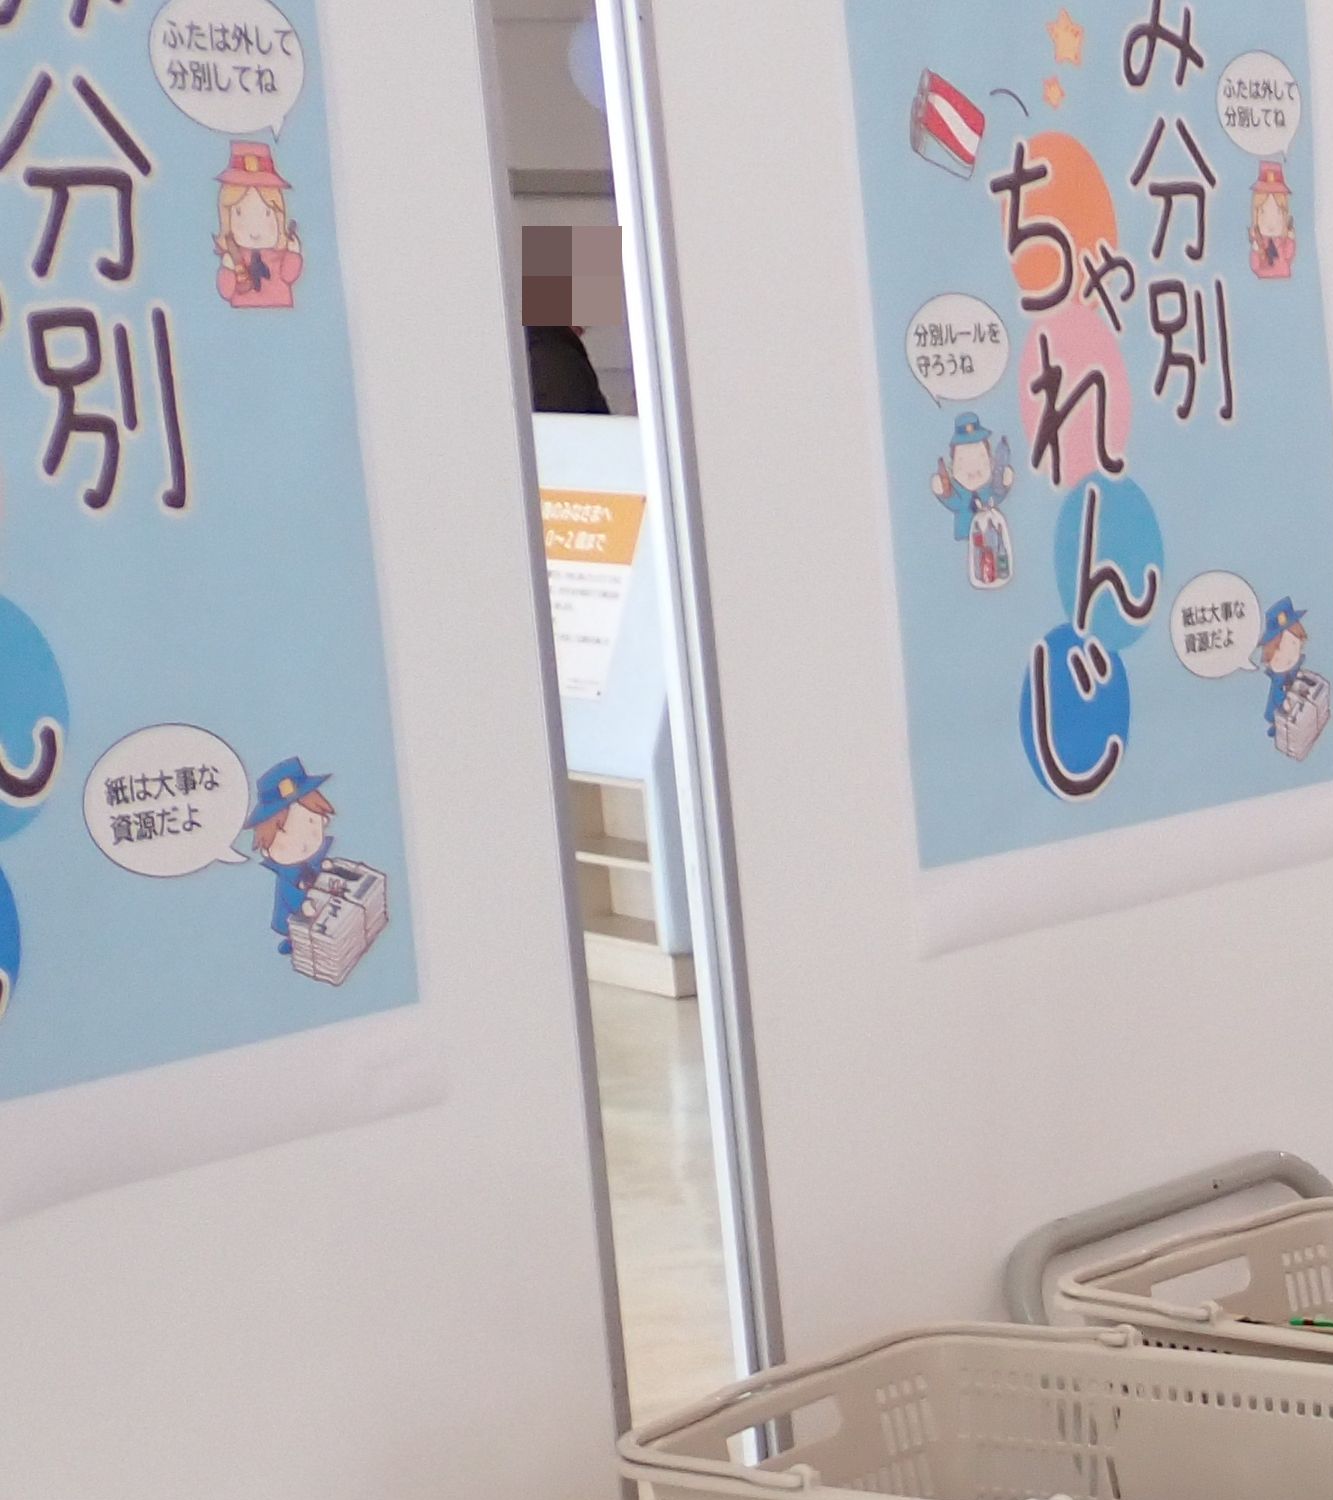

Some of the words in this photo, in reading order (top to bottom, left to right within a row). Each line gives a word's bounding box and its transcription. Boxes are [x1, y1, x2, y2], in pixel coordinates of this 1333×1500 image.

[162, 19, 296, 57] ふたは外して
[166, 58, 279, 93] 分別してね
[1222, 77, 1298, 101] ふたは外して
[1224, 104, 1287, 129] 分別してね
[0, 0, 187, 509] 分別
[912, 322, 1001, 348] 分別ルールを
[916, 353, 976, 378] 守ろうね
[988, 141, 1160, 798] ちゃれんじ
[1180, 600, 1248, 628] 紙は大事な
[1184, 629, 1236, 655] 資源だよ
[103, 762, 221, 806] 紙は大事な
[109, 805, 203, 845] 資源だよ
